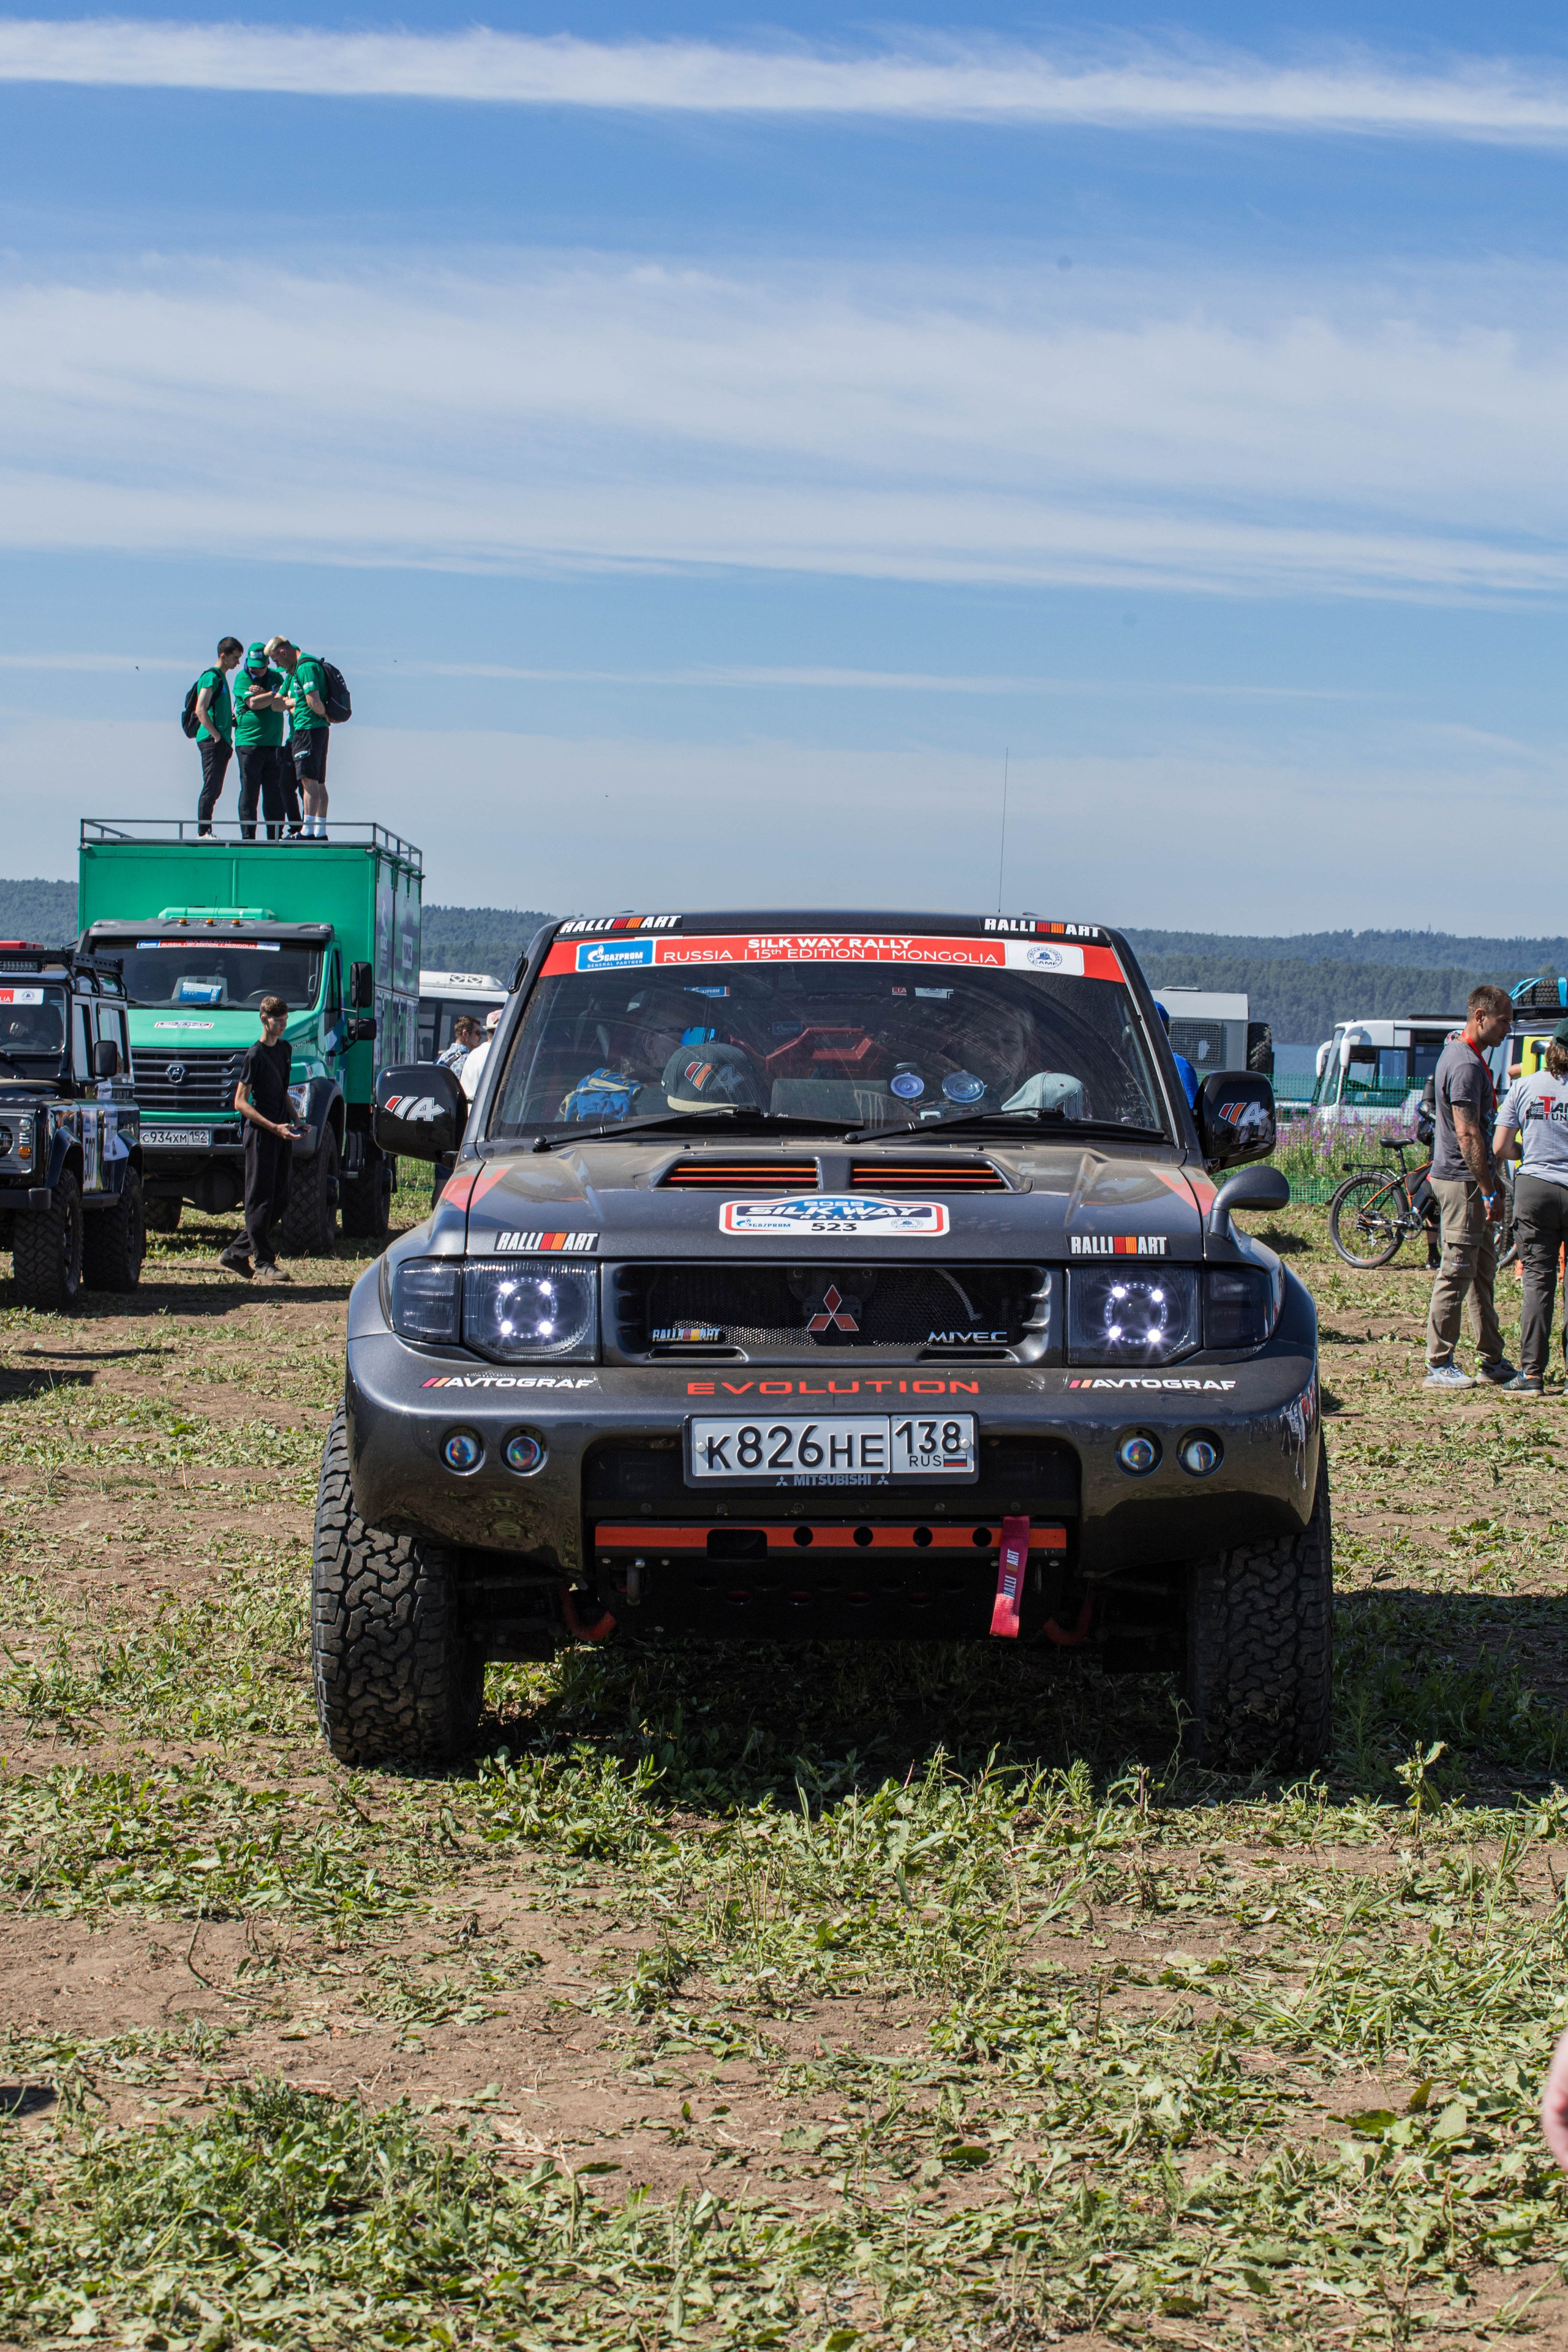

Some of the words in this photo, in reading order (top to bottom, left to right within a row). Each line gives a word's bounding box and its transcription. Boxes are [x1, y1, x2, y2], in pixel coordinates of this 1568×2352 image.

[559, 918, 616, 934] RALLI
[640, 915, 682, 929] ART
[984, 918, 1036, 932] RALLI
[1065, 924, 1101, 938] ART
[748, 938, 792, 948] SILK
[797, 938, 844, 948] WAY
[849, 938, 913, 949] RALLY
[604, 952, 643, 962] GAZPROM
[664, 950, 733, 962] RUSSIA
[754, 948, 782, 959] 15th
[787, 948, 865, 959] EDITION
[892, 949, 998, 964] MONGOLIA
[189, 1131, 206, 1140] 152
[85, 1137, 96, 1181] 507
[745, 1207, 837, 1215] SILK
[842, 1207, 923, 1216] WAY
[811, 1223, 858, 1231] 523
[496, 1232, 544, 1250] RALLI
[562, 1232, 598, 1251] ART
[1071, 1236, 1114, 1254] RALLI
[1137, 1236, 1167, 1254] ART
[652, 1328, 684, 1341] RALLI
[698, 1327, 720, 1341] ART
[928, 1332, 1008, 1343] MIVEC
[443, 1377, 595, 1389] AVTOGRAF
[687, 1381, 979, 1395] EVOLUTION
[1091, 1379, 1237, 1390] AVTOGRAF
[894, 1420, 961, 1454] 138
[909, 1455, 942, 1467] RUS
[794, 1474, 872, 1486] MITSUBISHI
[1006, 1548, 1019, 1566] ART
